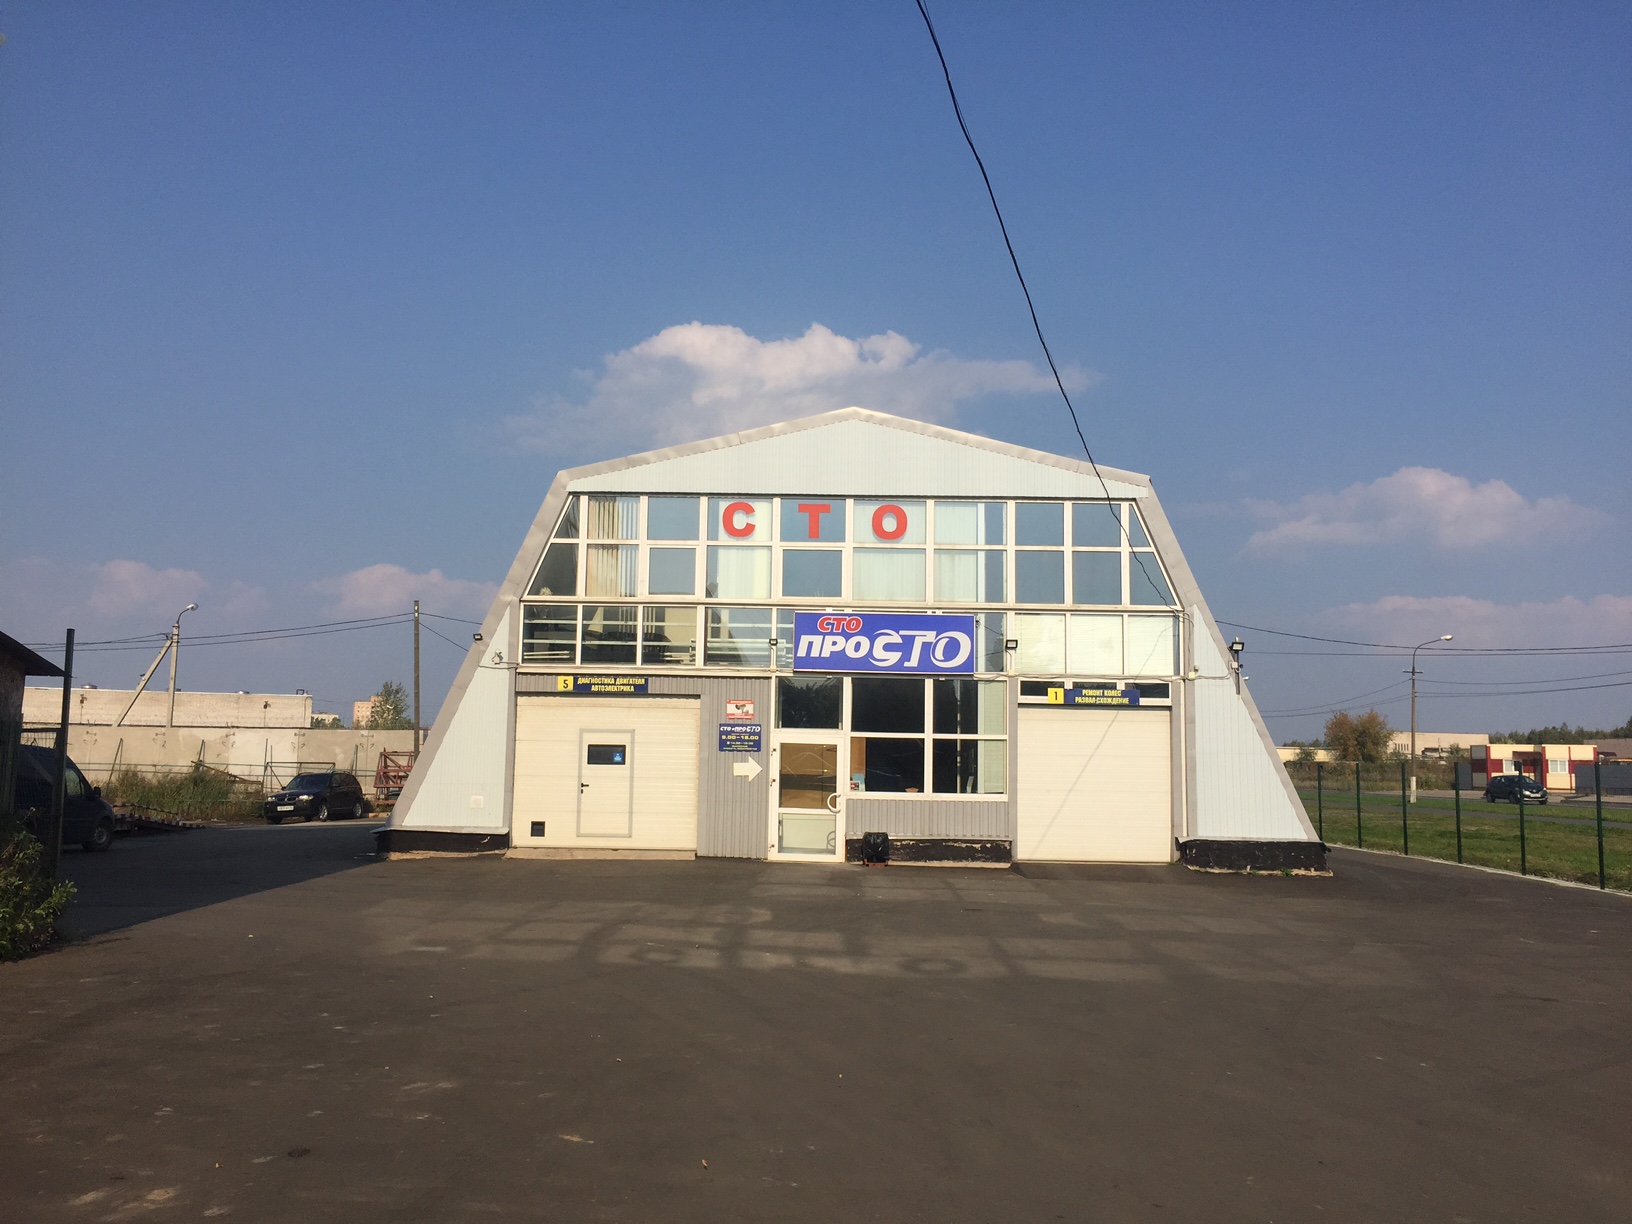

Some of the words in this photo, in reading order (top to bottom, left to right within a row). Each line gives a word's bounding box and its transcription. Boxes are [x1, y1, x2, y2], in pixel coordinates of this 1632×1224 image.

[722, 501, 908, 541] СТО
[817, 616, 863, 633] СТО
[796, 629, 972, 668] ПРОСТО
[563, 679, 569, 689] 5
[577, 677, 615, 685] ДИАГНОСТИКА
[615, 678, 646, 686] ДВИГАТЕЛЯ
[1054, 692, 1058, 700] 1
